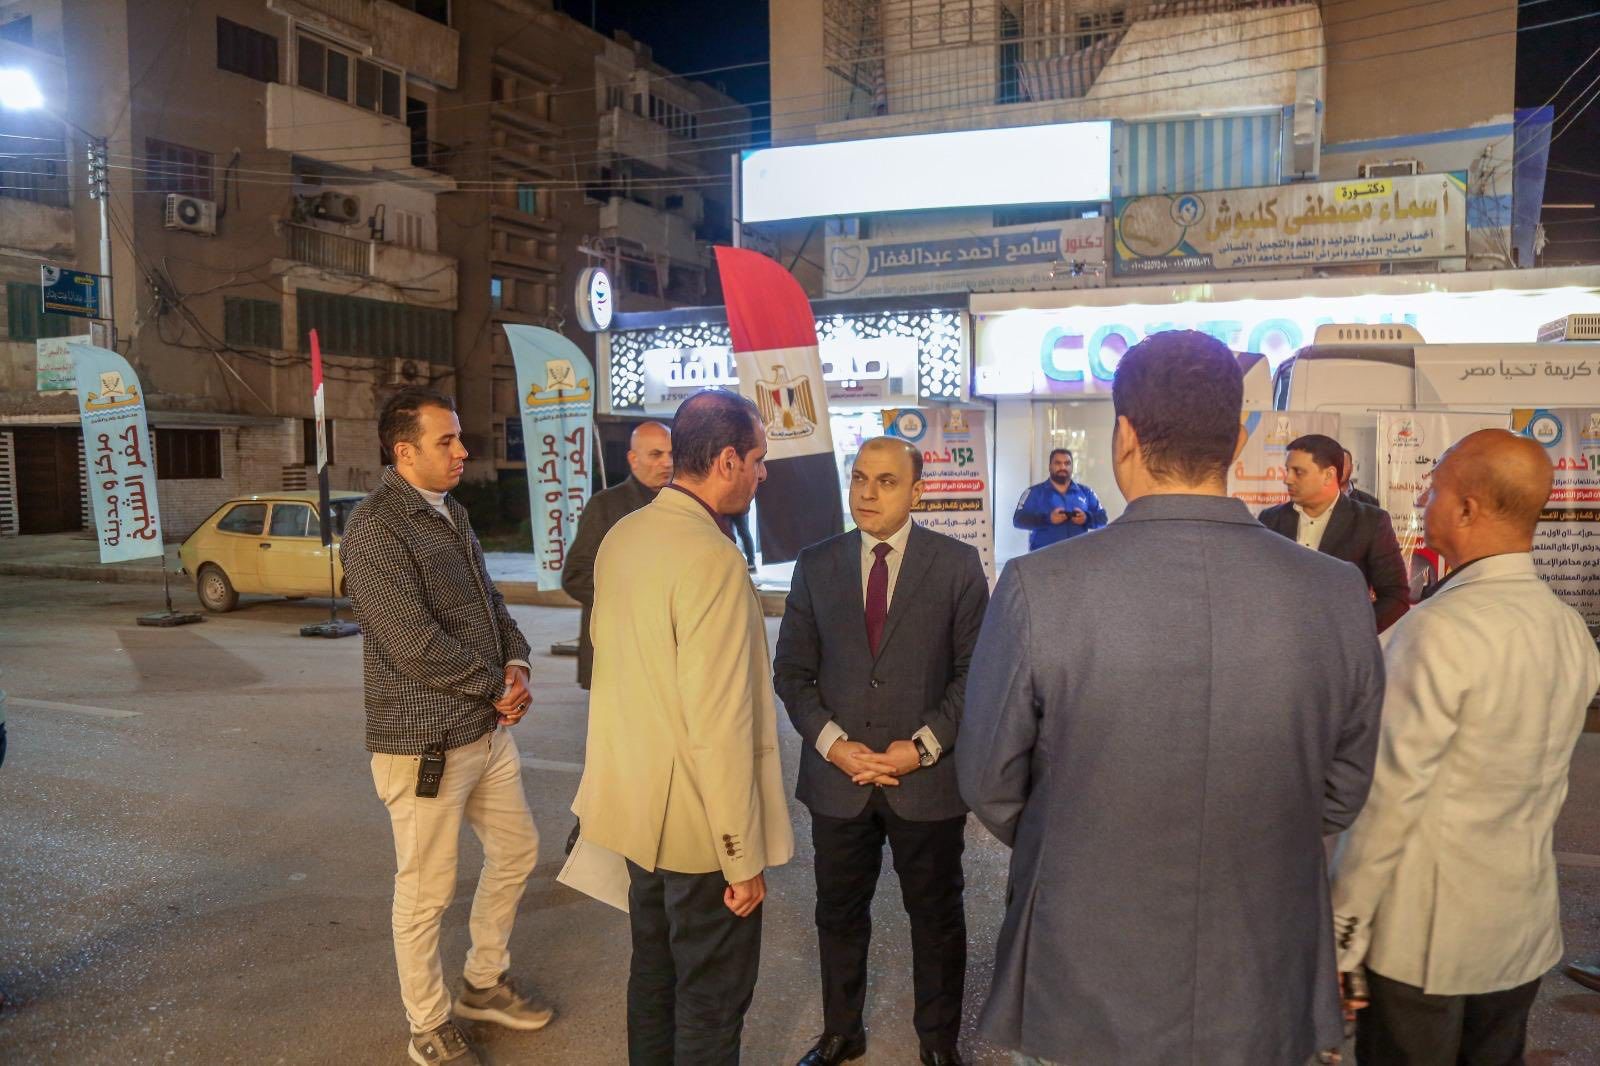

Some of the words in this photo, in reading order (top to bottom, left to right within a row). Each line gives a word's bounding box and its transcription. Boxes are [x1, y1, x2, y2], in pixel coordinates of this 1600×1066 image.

[1283, 193, 1373, 235] مصطفى
[1379, 181, 1449, 227] أسماء
[957, 237, 999, 262] أحمد
[1006, 236, 1057, 262] سامح
[1064, 234, 1104, 254] دكتور
[1459, 366, 1496, 381] مصر
[1499, 359, 1538, 380] تحيا
[1544, 360, 1592, 380] كريمة
[95, 433, 118, 475] مركز
[118, 424, 147, 468] كفر
[564, 426, 588, 479] كفر
[923, 446, 952, 465] خدم
[952, 447, 975, 468] 152
[538, 434, 562, 484] مركز
[1553, 453, 1588, 471] خدم
[103, 480, 119, 490] و
[545, 491, 563, 503] و
[121, 474, 157, 541] الشيخ
[104, 495, 123, 547] مدينة
[542, 508, 567, 571] مدينة
